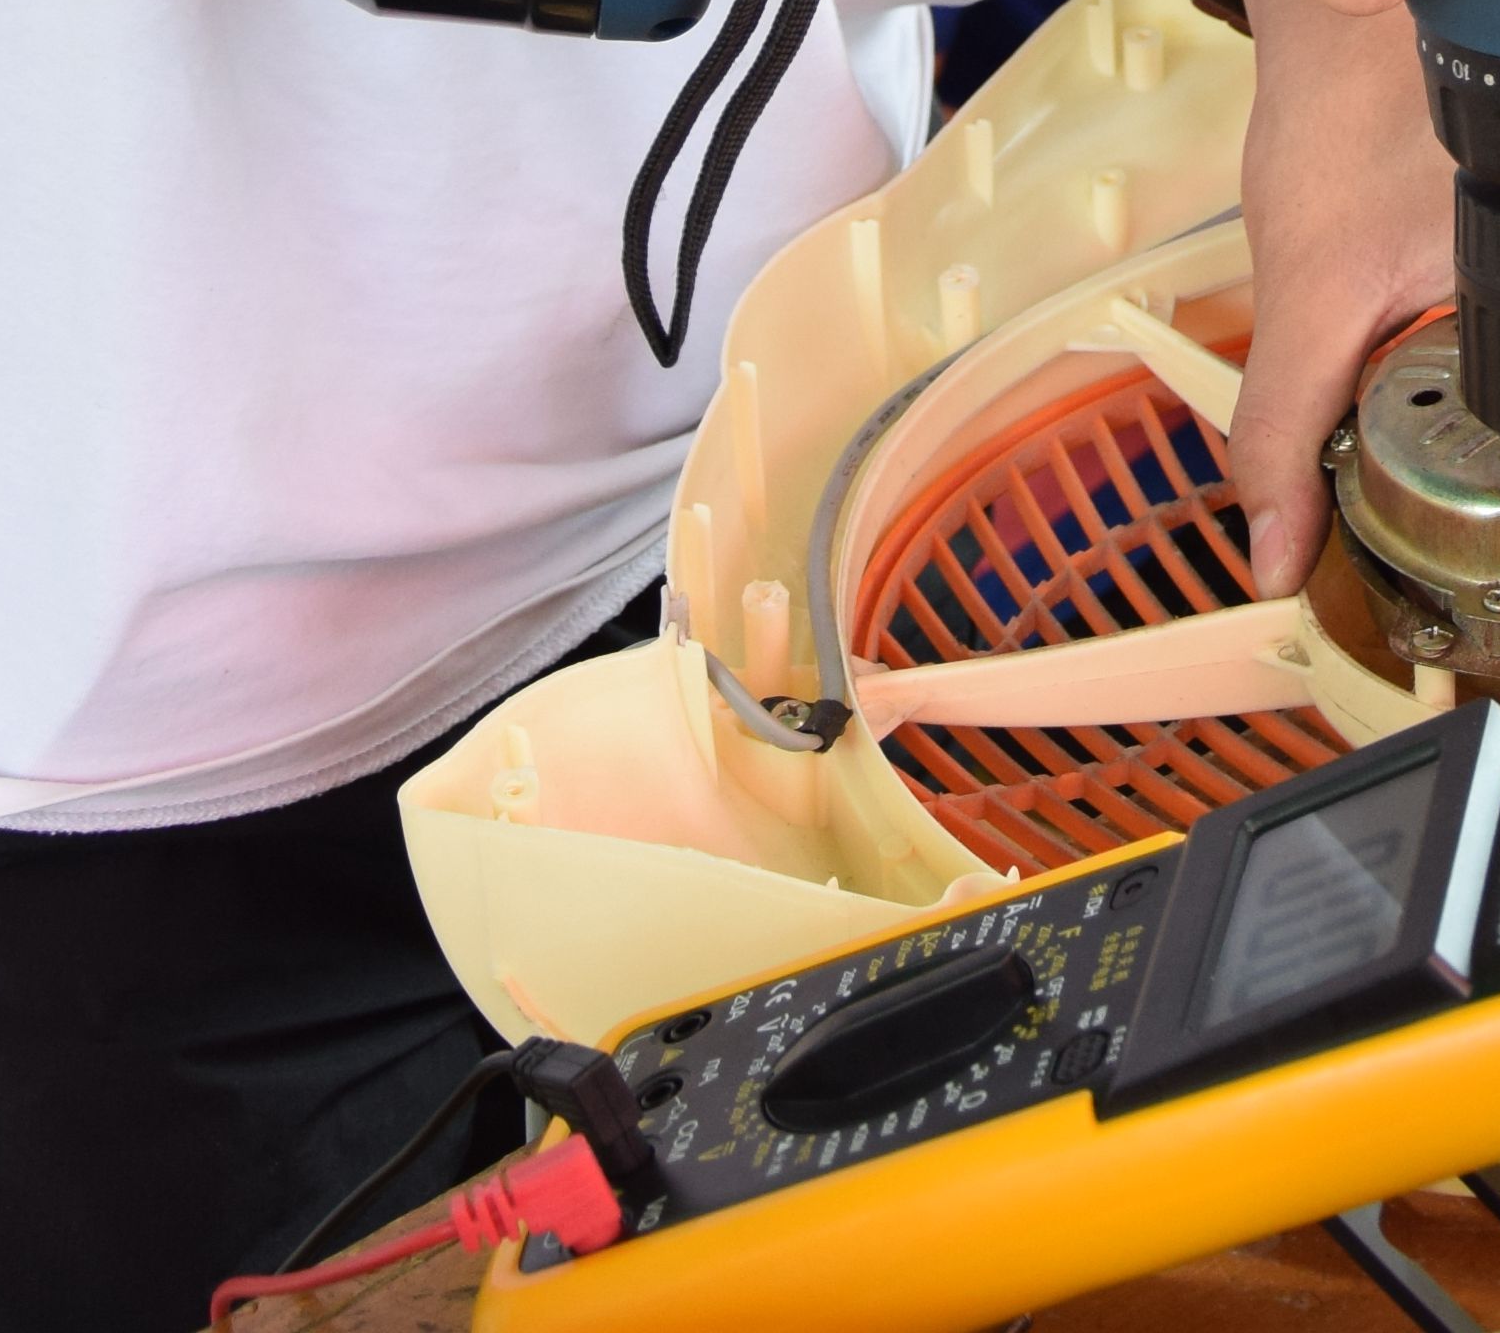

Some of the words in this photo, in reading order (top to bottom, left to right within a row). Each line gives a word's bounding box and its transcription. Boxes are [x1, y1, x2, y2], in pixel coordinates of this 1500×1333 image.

[1451, 59, 1470, 81] 10
[725, 991, 753, 1023] 20A
[666, 1119, 698, 1164] COM
